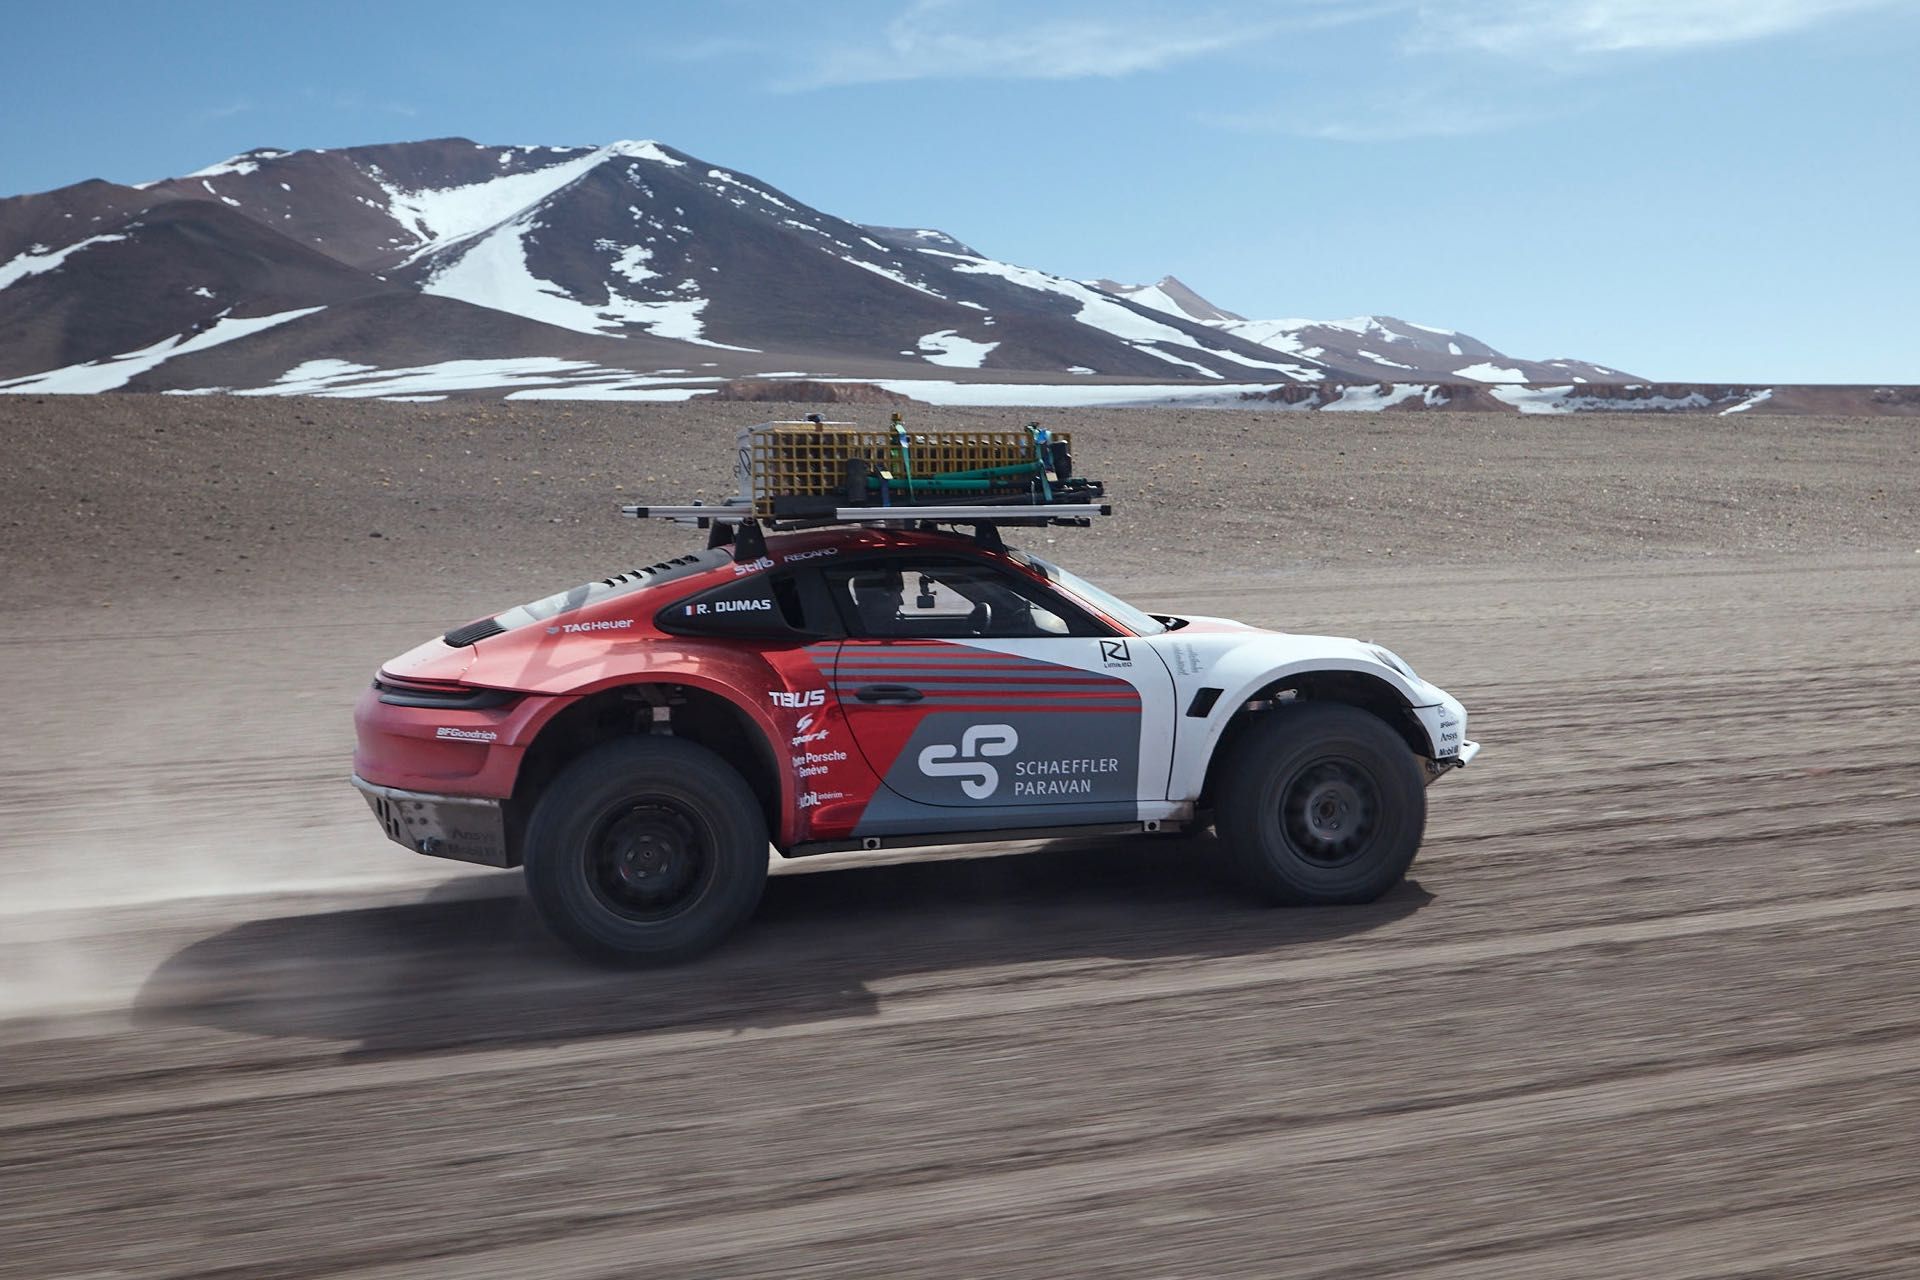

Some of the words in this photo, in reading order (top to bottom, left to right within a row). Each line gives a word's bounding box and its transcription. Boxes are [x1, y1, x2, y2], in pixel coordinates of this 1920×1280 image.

[783, 547, 838, 562] RECARO
[697, 603, 711, 615] R.
[715, 599, 772, 613] DUMAS
[436, 727, 497, 742] BFGoodrich
[806, 750, 847, 763] Porsche
[1015, 758, 1119, 776] SCHAEFFLER
[1014, 779, 1091, 796] PARAVAN
